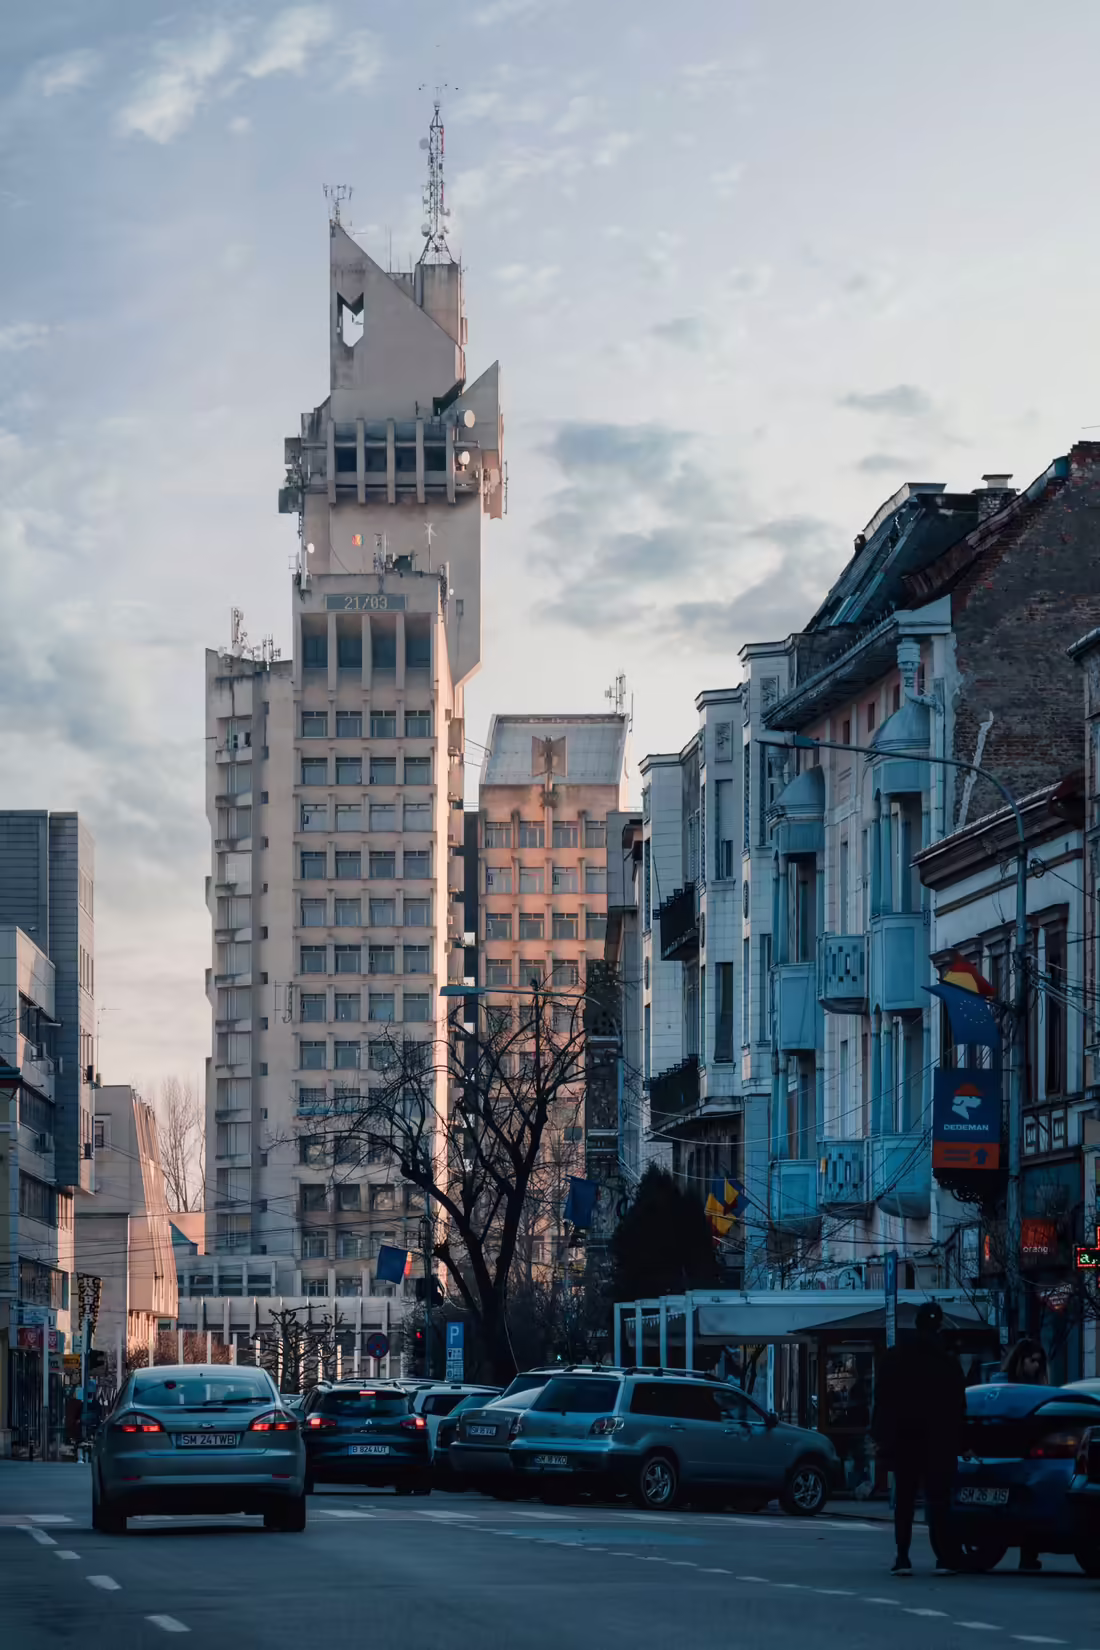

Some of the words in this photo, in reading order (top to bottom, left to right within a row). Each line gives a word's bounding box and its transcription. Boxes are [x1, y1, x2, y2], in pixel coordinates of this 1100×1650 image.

[344, 595, 388, 610] 21/03
[943, 1123, 989, 1131] DEDEMAN
[1022, 1246, 1053, 1254] orang
[450, 1325, 460, 1345] P
[183, 1434, 197, 1445] SM
